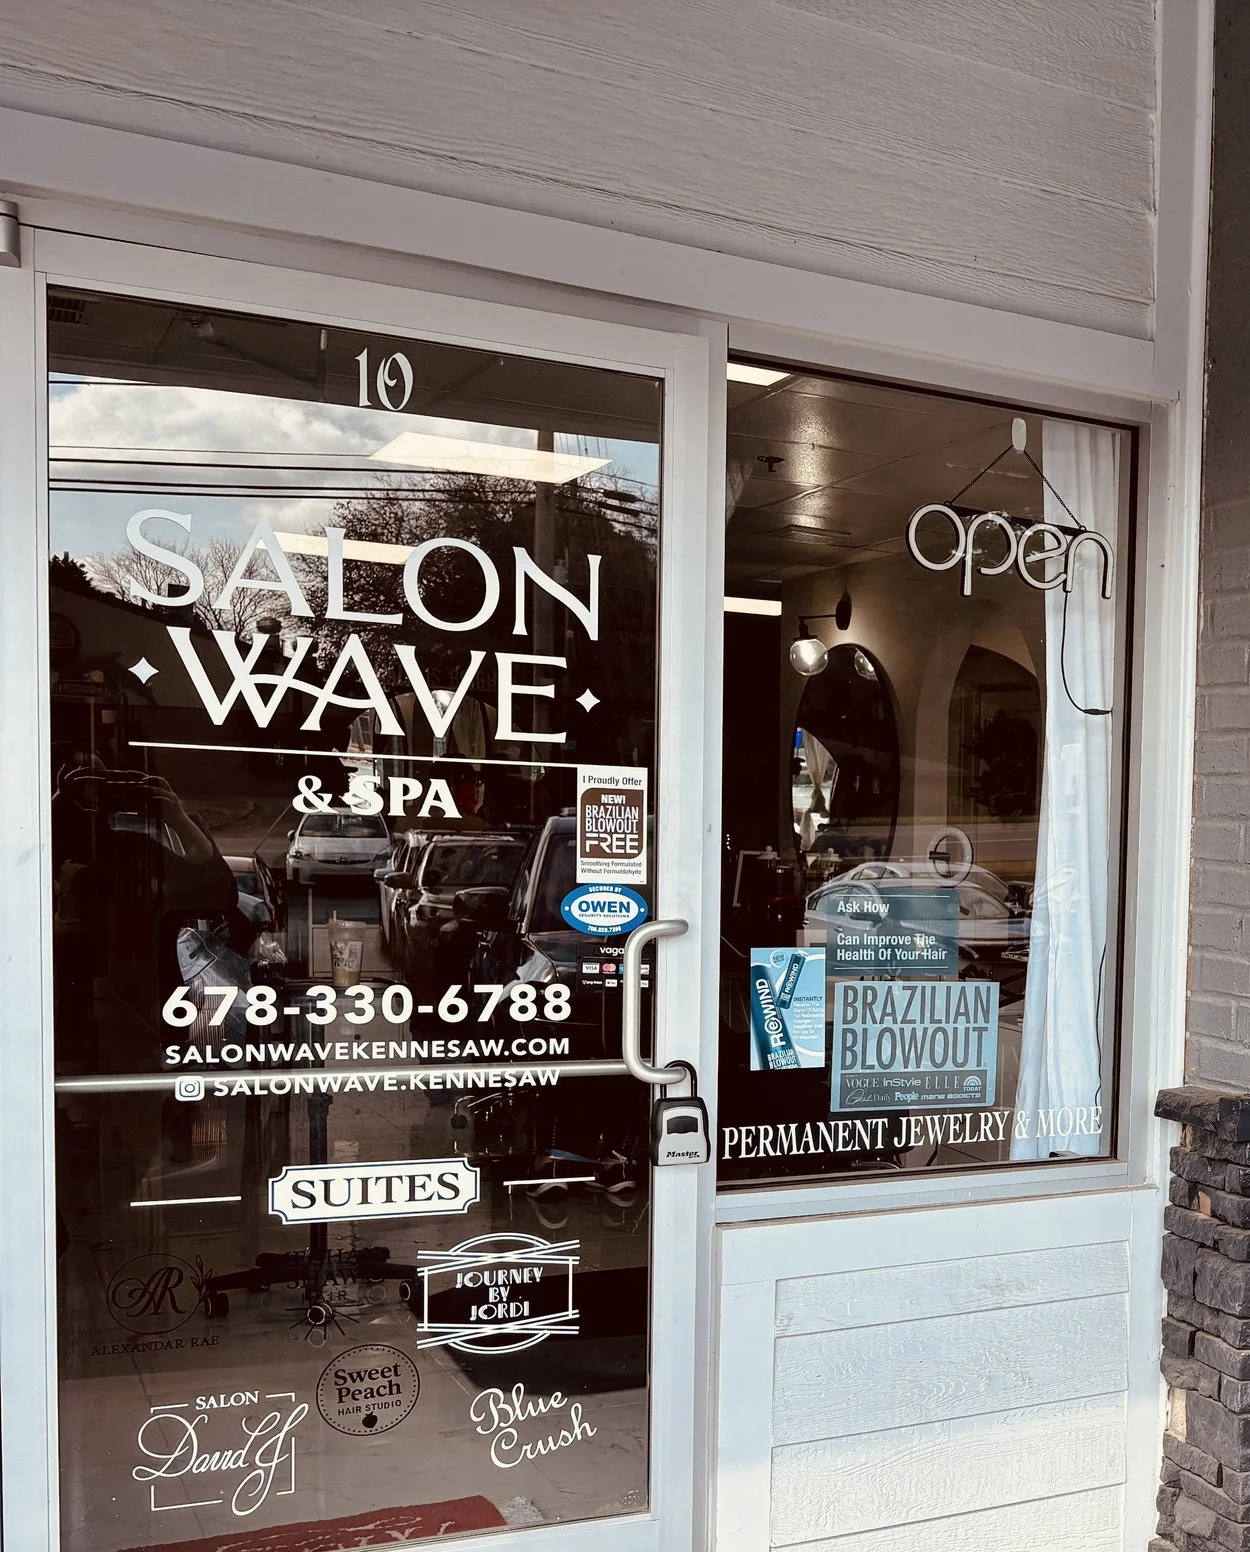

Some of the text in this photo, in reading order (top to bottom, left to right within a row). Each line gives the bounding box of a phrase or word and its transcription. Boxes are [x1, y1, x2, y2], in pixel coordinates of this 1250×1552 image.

[354, 346, 414, 411] 10
[905, 502, 1114, 600] open
[126, 508, 602, 641] SALON
[166, 625, 568, 744] WAVE
[588, 775, 620, 787] Proudly
[622, 776, 642, 786] Offer
[292, 774, 463, 819] & SPA
[600, 794, 626, 805] NEW!
[585, 804, 639, 820] BRAZILIAN
[585, 818, 639, 834] BLOWOUT
[585, 832, 639, 854] FREE
[577, 900, 631, 914] OWEN
[837, 900, 890, 914] Ask How
[836, 932, 936, 948] Can Improve The
[599, 946, 625, 957] vaga
[836, 948, 948, 961] Health Of Your Hair
[161, 984, 572, 1027] 678-330-6788
[842, 985, 991, 1026] BRAZILIAN
[165, 1037, 571, 1065] SALONWAVEKENNESAW.COM
[841, 1027, 988, 1071] BLOWOUT
[213, 1068, 561, 1097] SALONWAVE.KENNESAW
[845, 1078, 880, 1088] VOGUE
[883, 1077, 922, 1088] InStyle
[894, 1091, 919, 1103] People
[722, 1106, 1104, 1160] PERMANENT JEWELRY & MORE
[666, 1150, 699, 1159] Master
[291, 1172, 461, 1210] SUITES
[455, 1266, 544, 1289] JOURNEY
[488, 1286, 510, 1303] BY
[470, 1301, 530, 1321] JORDI
[91, 1335, 220, 1357] ALEXANDAR RAE
[333, 1362, 401, 1387] Sweet
[195, 1391, 259, 1411] SALON
[335, 1378, 402, 1404] Peach
[337, 1399, 402, 1416] HAIR STUDIO
[469, 1382, 568, 1435] Blue
[490, 1402, 598, 1468] Crush
